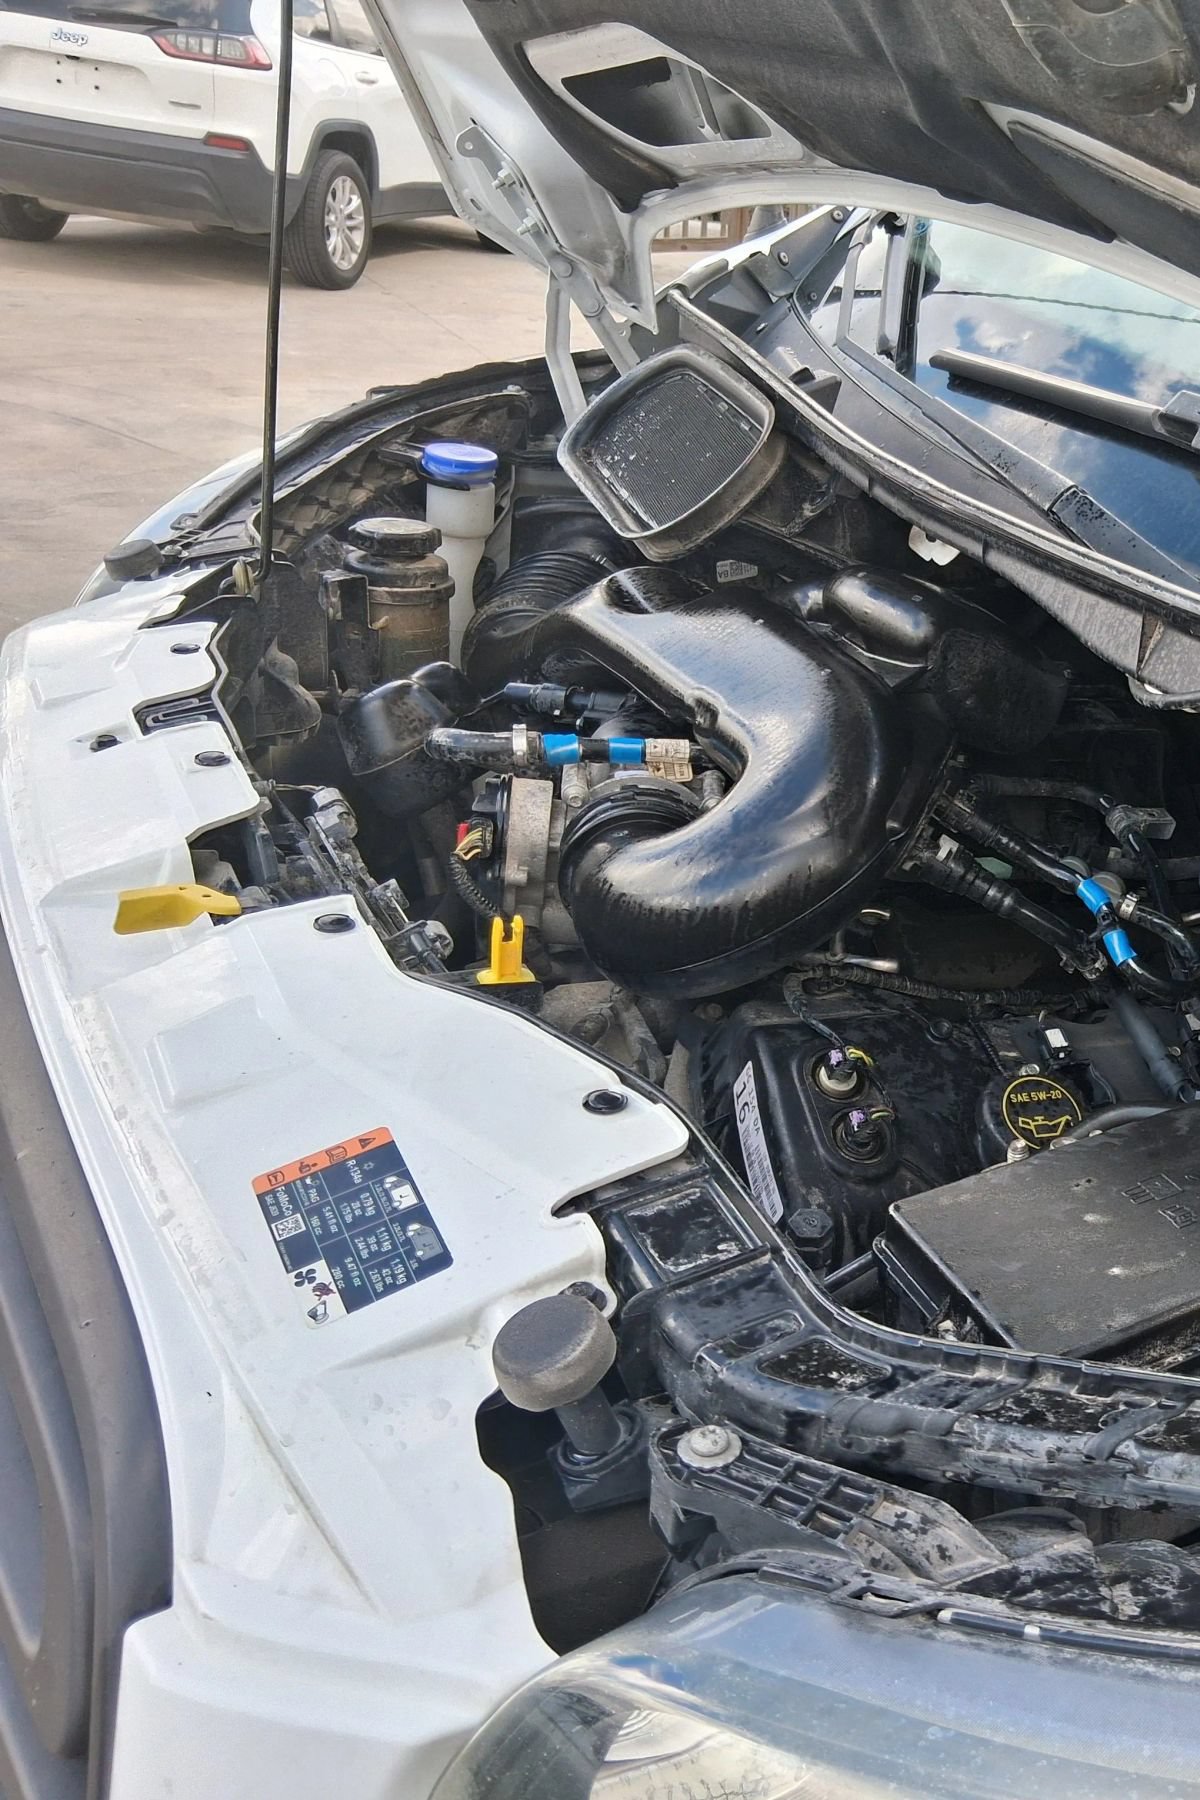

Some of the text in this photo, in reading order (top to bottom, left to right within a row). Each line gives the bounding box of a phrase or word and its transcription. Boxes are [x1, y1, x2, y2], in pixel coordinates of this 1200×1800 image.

[52, 28, 88, 46] Jeep
[735, 1082, 751, 1126] 16
[1010, 1090, 1062, 1103] SAE 5W-20
[346, 1160, 362, 1184] R-134a
[265, 1194, 275, 1206] SAE
[275, 1186, 292, 1216] FoMoCo
[308, 1188, 320, 1202] PAG
[360, 1193, 375, 1216] 0.79 kg
[323, 1206, 334, 1219] 5.41
[330, 1225, 338, 1233] oz
[355, 1237, 369, 1258] 2.44 lbs
[376, 1228, 391, 1251] 1.11 kg
[345, 1257, 356, 1270] 9.47
[353, 1278, 361, 1286] oz
[385, 1276, 393, 1284] oz
[391, 1259, 406, 1284] 1.19 kg
[337, 1280, 345, 1289] cc
